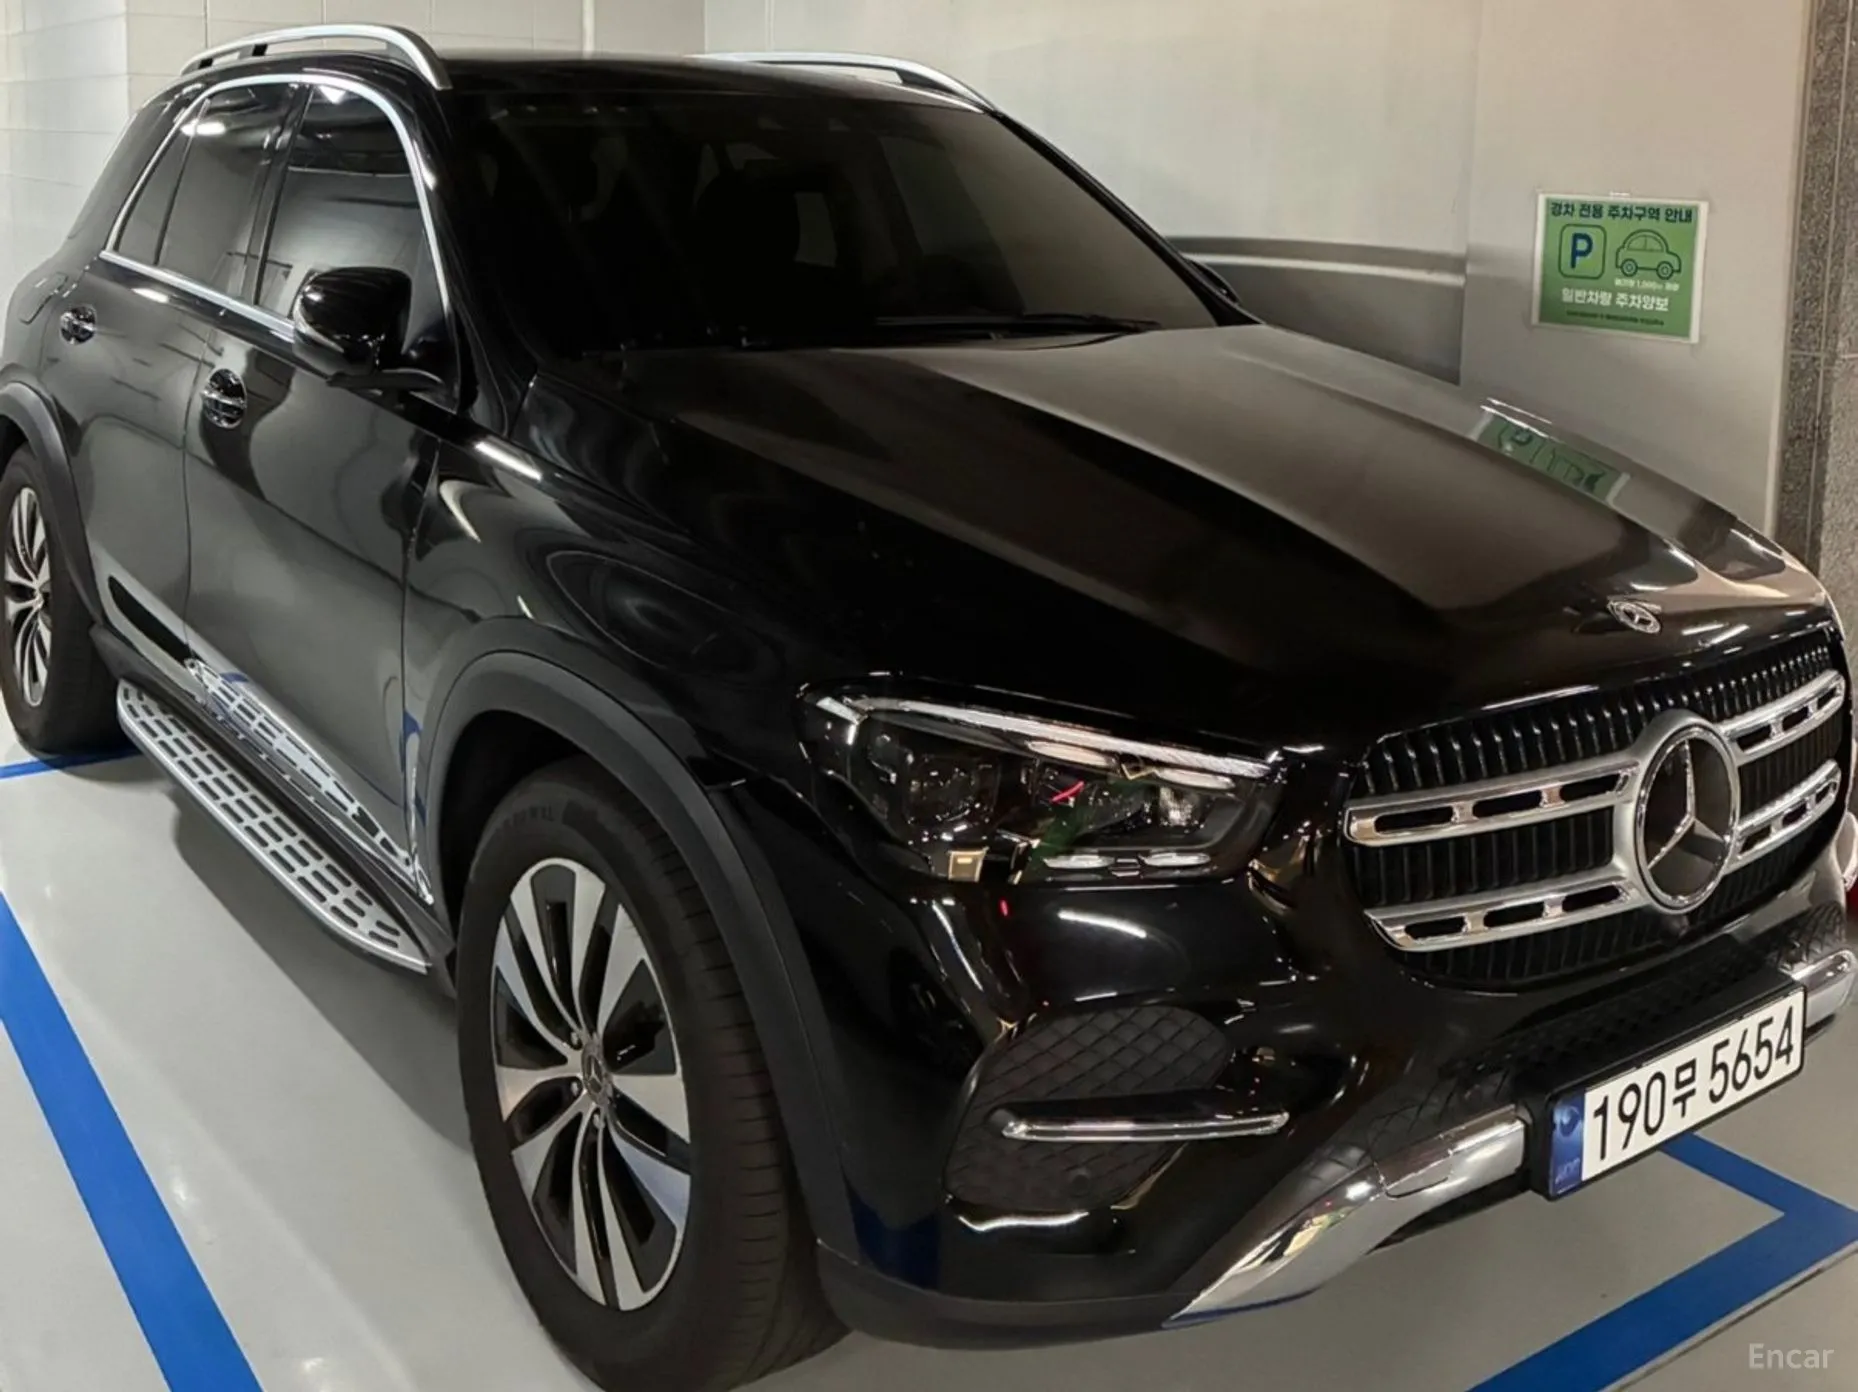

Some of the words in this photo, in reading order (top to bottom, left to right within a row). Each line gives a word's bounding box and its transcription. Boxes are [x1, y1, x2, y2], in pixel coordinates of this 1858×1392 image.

[1551, 202, 1575, 217] 경차
[1579, 204, 1603, 219] 전용
[1608, 205, 1660, 221] 주차구역
[1665, 208, 1692, 223] 안내
[1571, 232, 1593, 269] P
[1562, 287, 1612, 306] 일반차량
[1615, 292, 1669, 311] 주차양보
[1593, 1058, 1697, 1161] 190무
[1708, 1006, 1794, 1104] 5654
